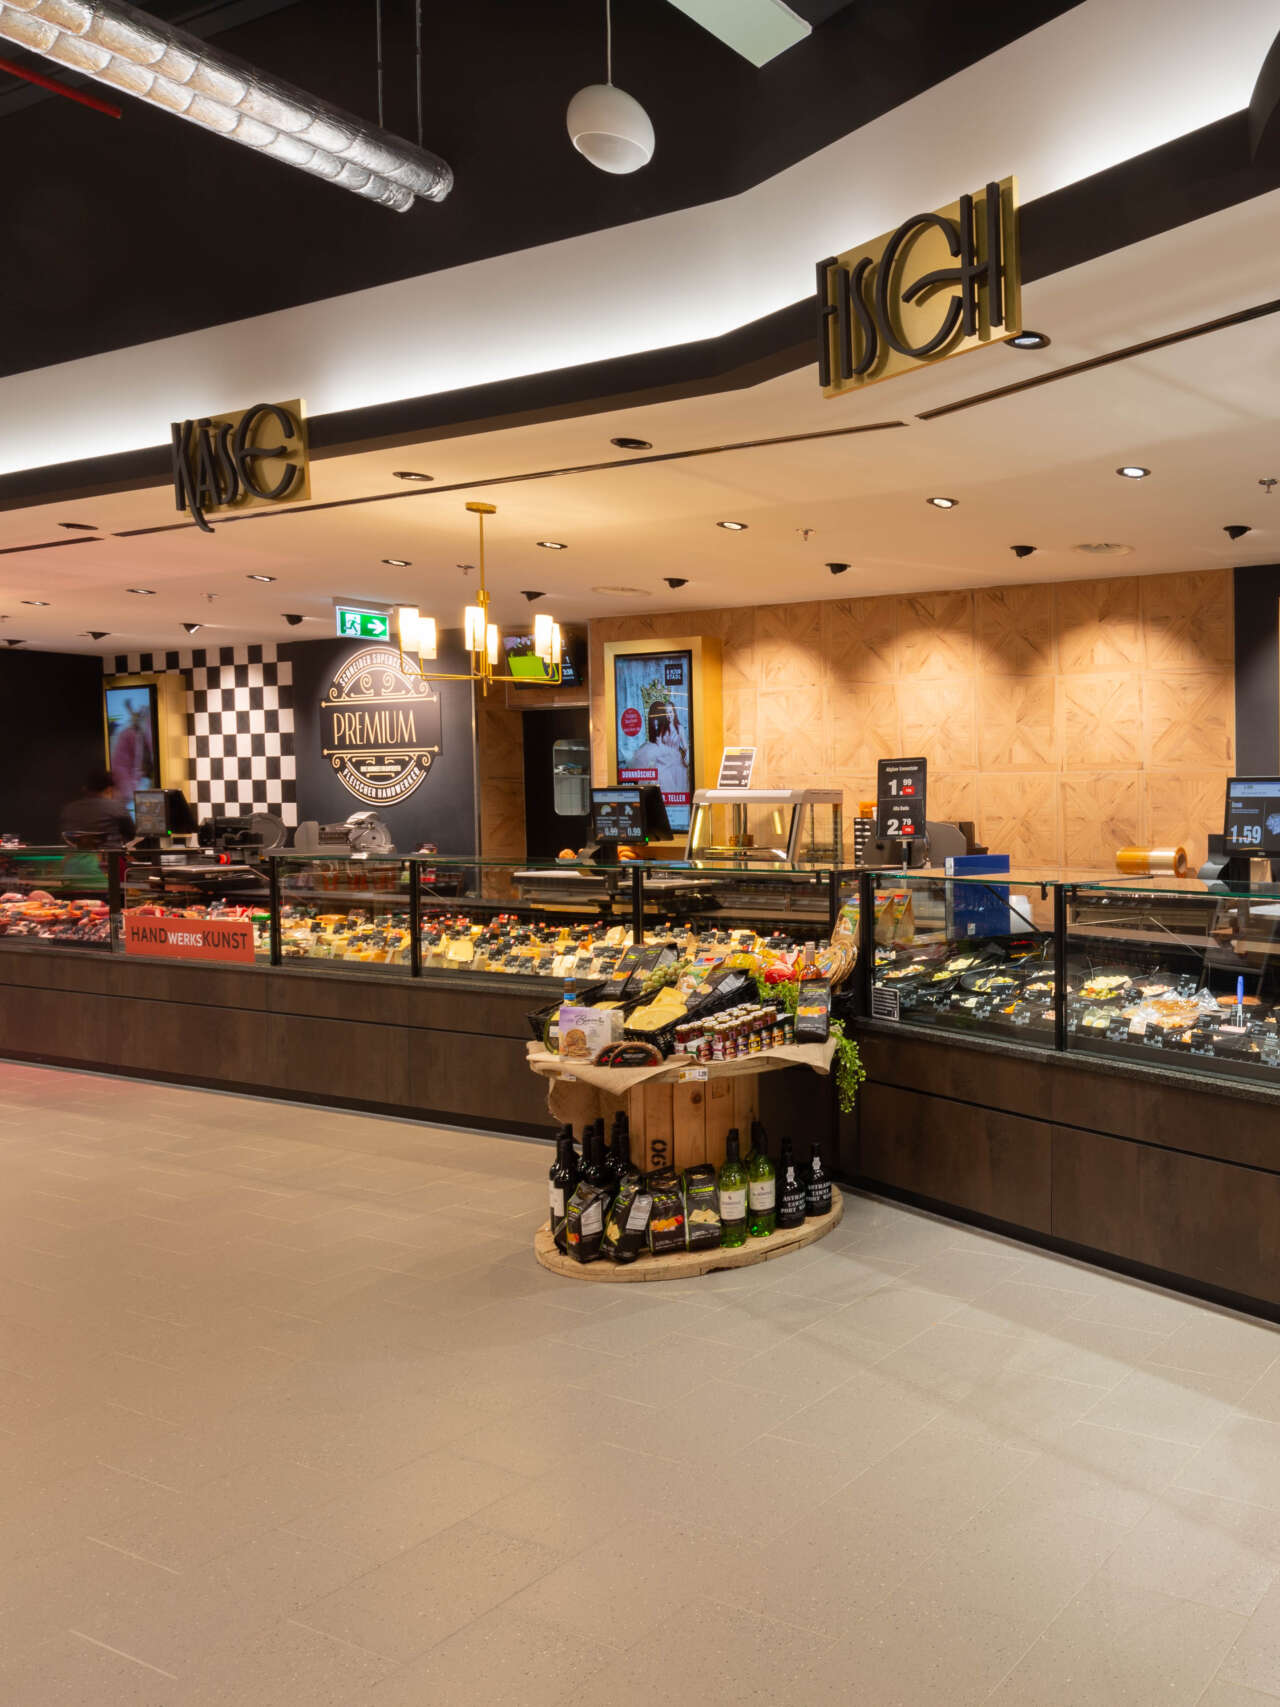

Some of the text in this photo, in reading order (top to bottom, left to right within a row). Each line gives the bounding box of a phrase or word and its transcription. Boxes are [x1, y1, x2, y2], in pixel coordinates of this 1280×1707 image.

[333, 710, 417, 745] PREMIUM
[343, 767, 421, 798] FLEISCHER HANDWERKER
[1231, 824, 1262, 844] 1.59
